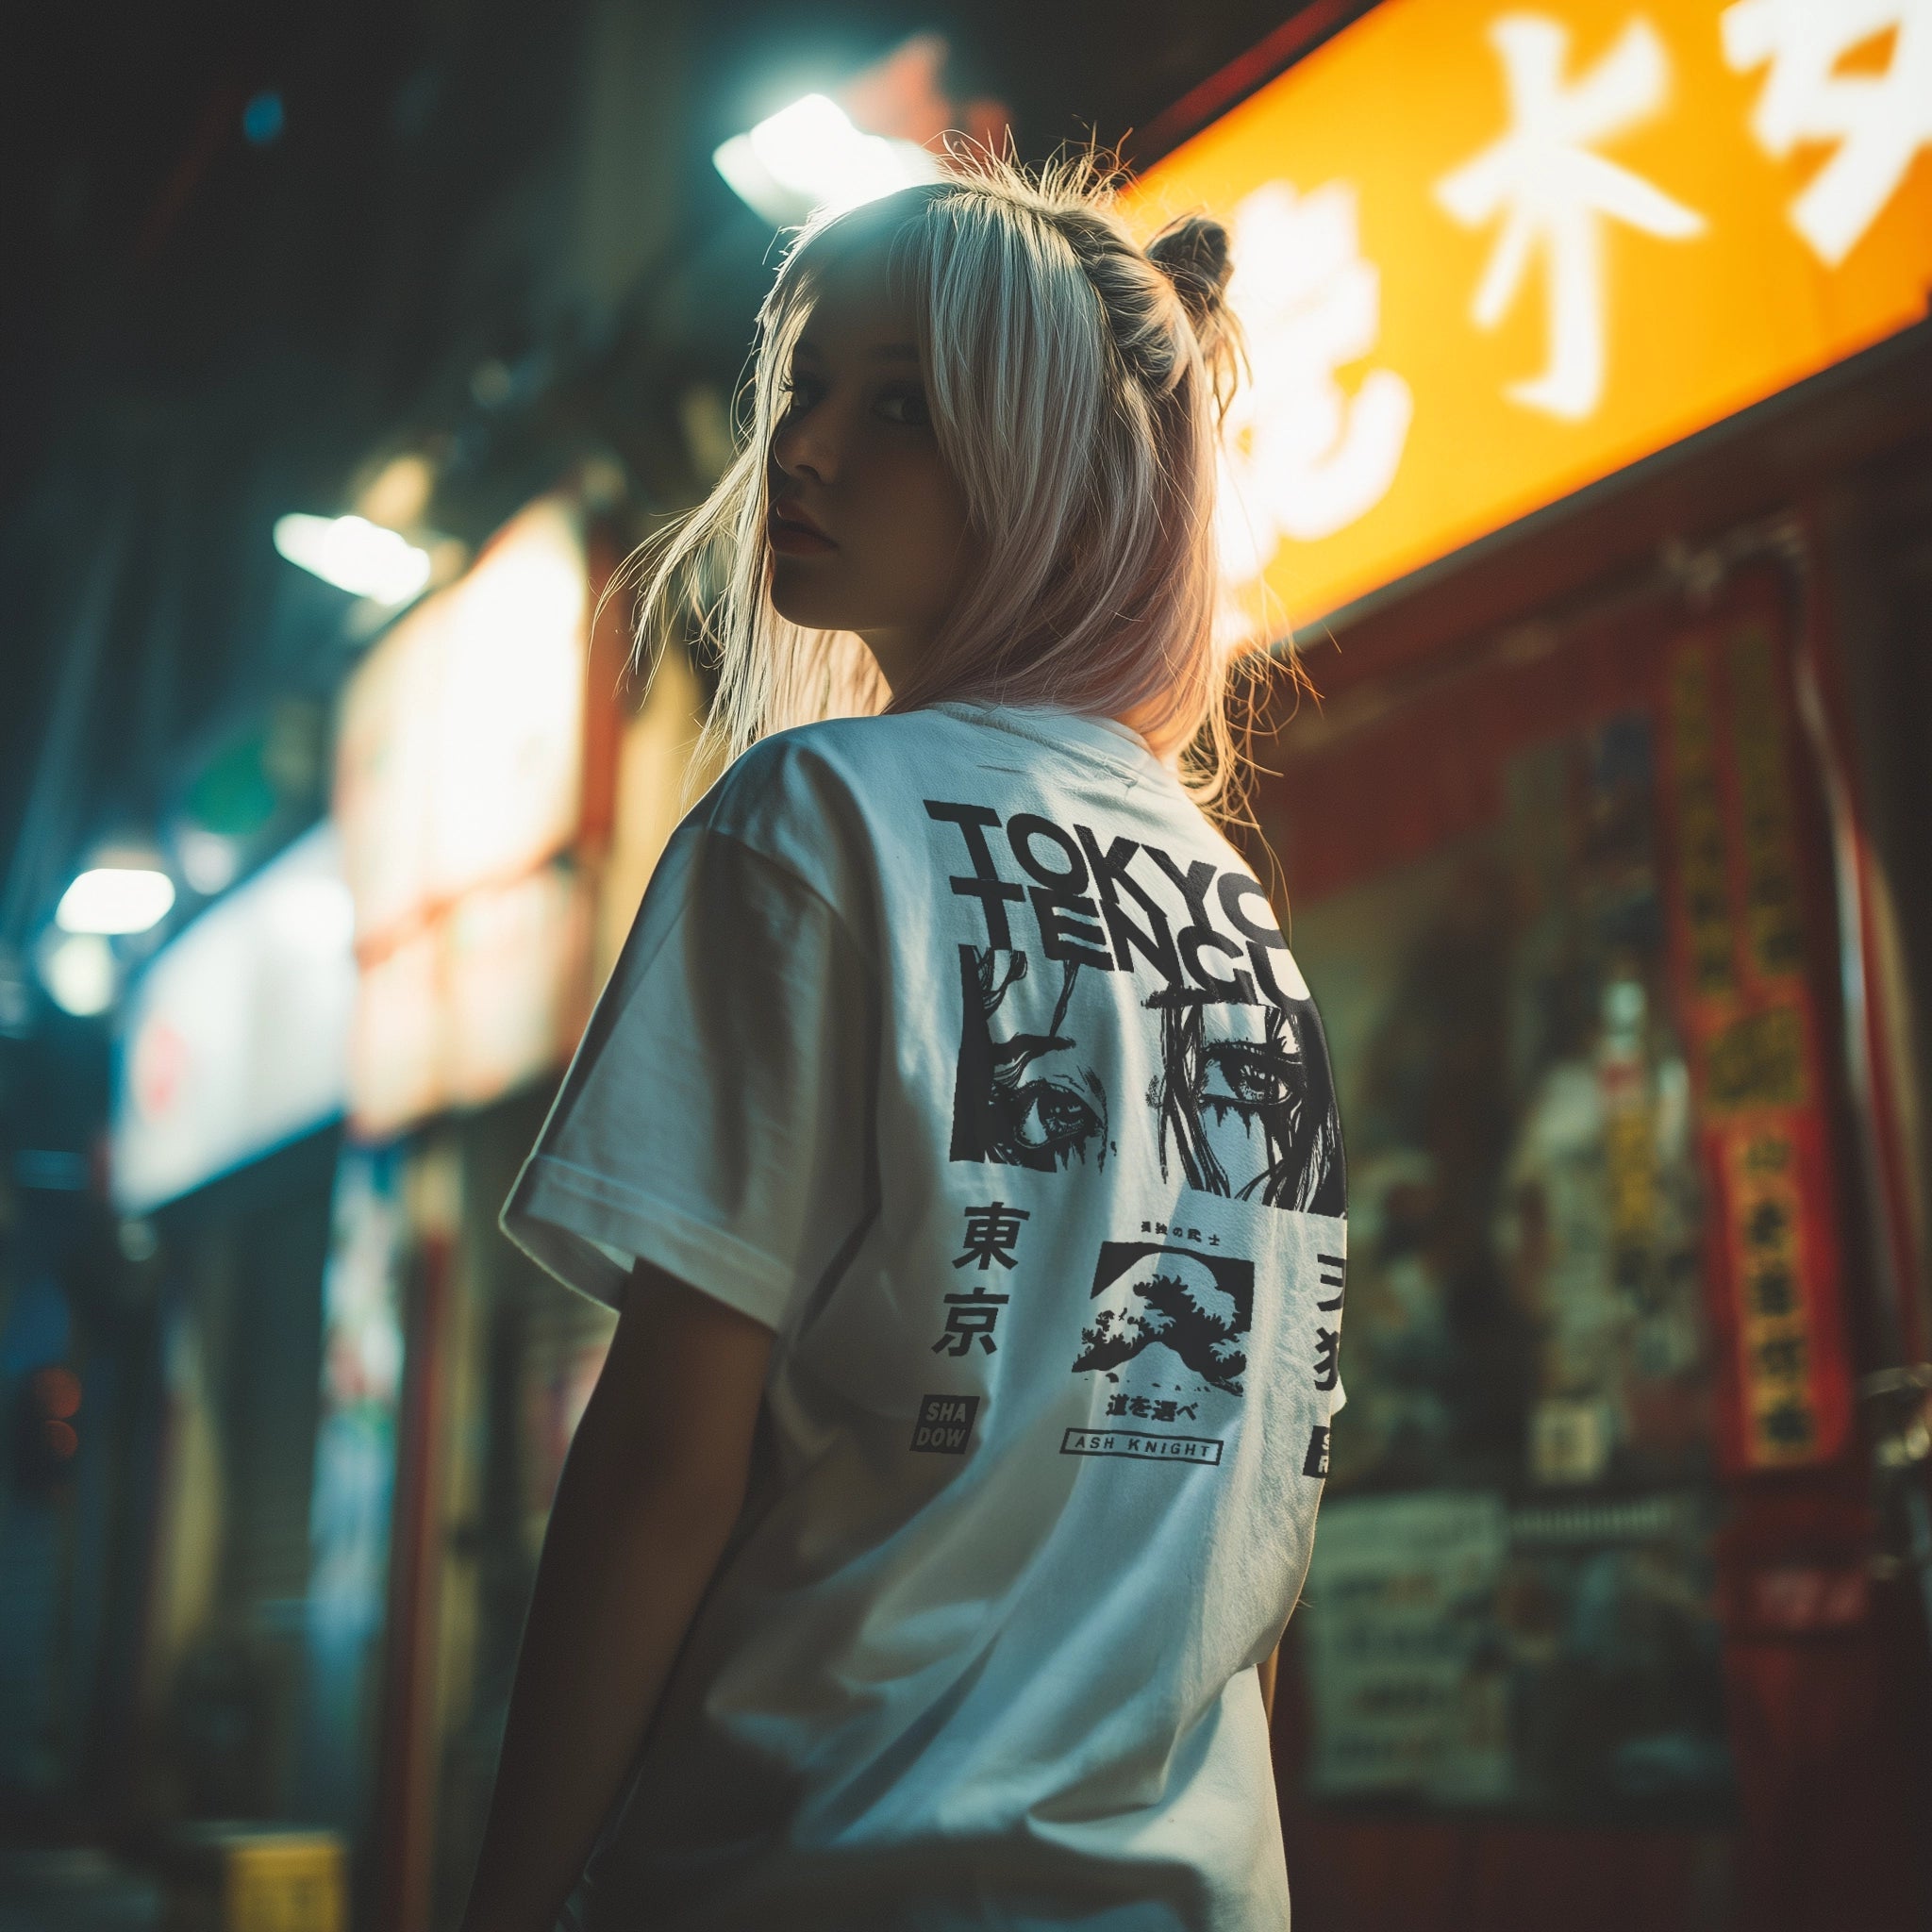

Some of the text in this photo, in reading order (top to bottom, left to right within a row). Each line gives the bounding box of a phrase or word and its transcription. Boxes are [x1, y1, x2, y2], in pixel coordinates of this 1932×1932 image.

[924, 799, 1289, 950] TOKYO
[931, 1202, 1030, 1357] 東京
[926, 1402, 966, 1423] SHA
[916, 1426, 966, 1448] DOW
[1074, 1436, 1114, 1449] ASH
[1127, 1439, 1210, 1457] KNIGHT
